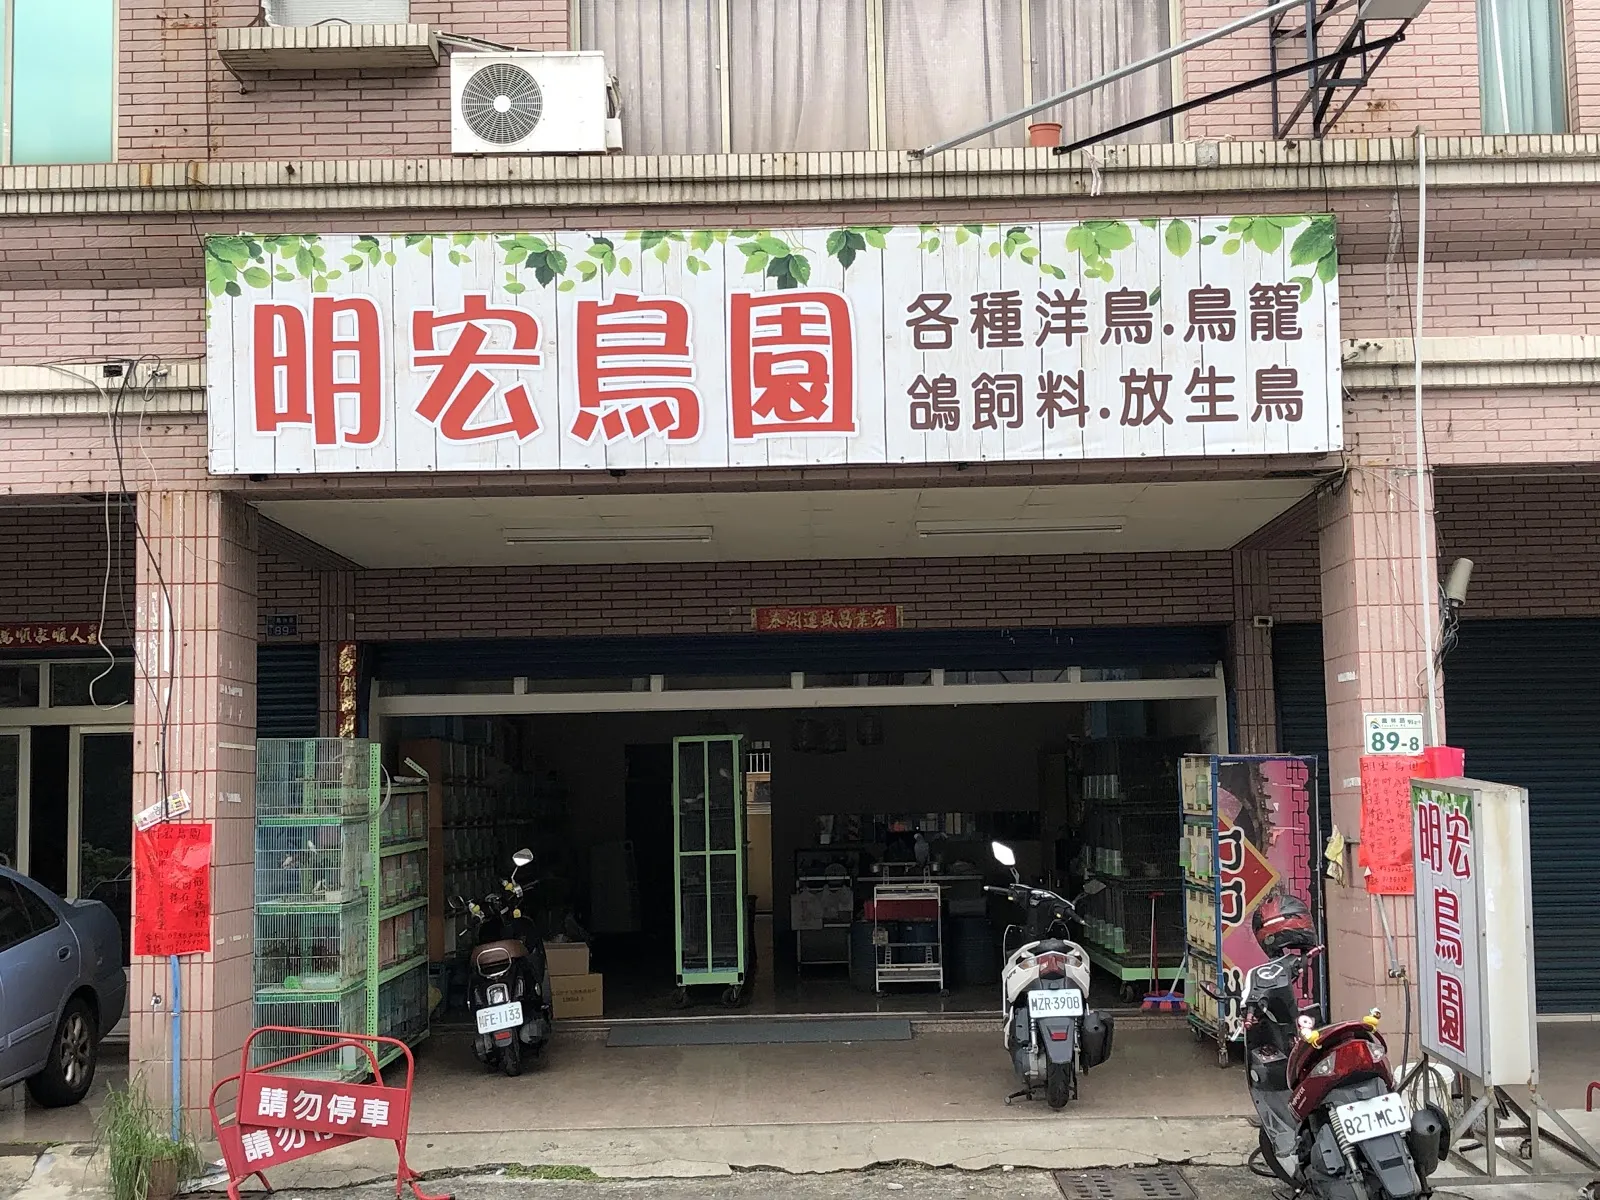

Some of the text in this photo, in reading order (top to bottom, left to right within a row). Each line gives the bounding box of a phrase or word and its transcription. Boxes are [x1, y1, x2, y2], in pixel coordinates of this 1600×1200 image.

[251, 291, 857, 446] 明宏鳥園
[1371, 731, 1420, 751] 89-8
[1031, 997, 1080, 1011] MZR-3908
[257, 1087, 390, 1128] 請勿停車
[1343, 1105, 1408, 1137] 827-MCJ
